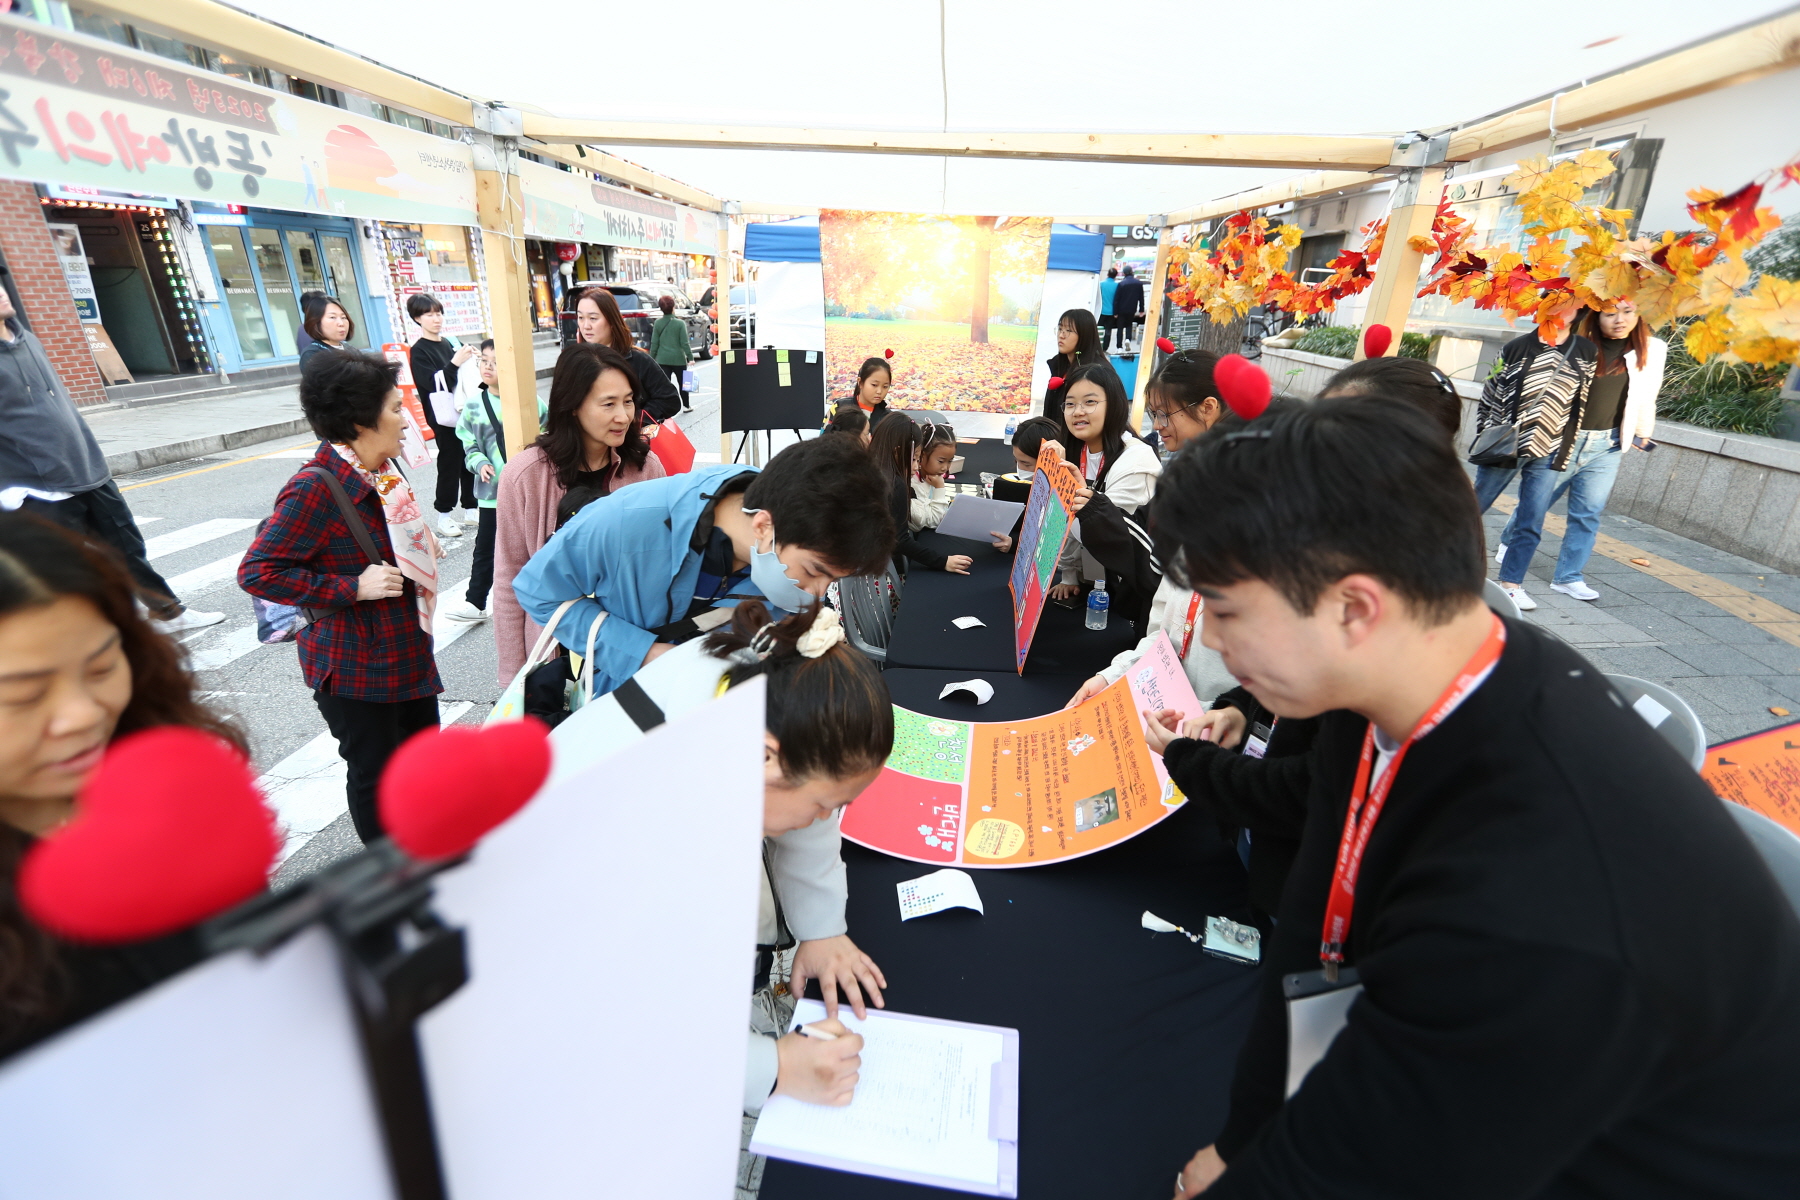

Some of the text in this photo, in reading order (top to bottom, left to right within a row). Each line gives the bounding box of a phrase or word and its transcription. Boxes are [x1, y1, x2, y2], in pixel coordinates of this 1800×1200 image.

[390, 239, 417, 257] 서광
[934, 736, 965, 765] 찬성
[933, 804, 961, 838] 반대
